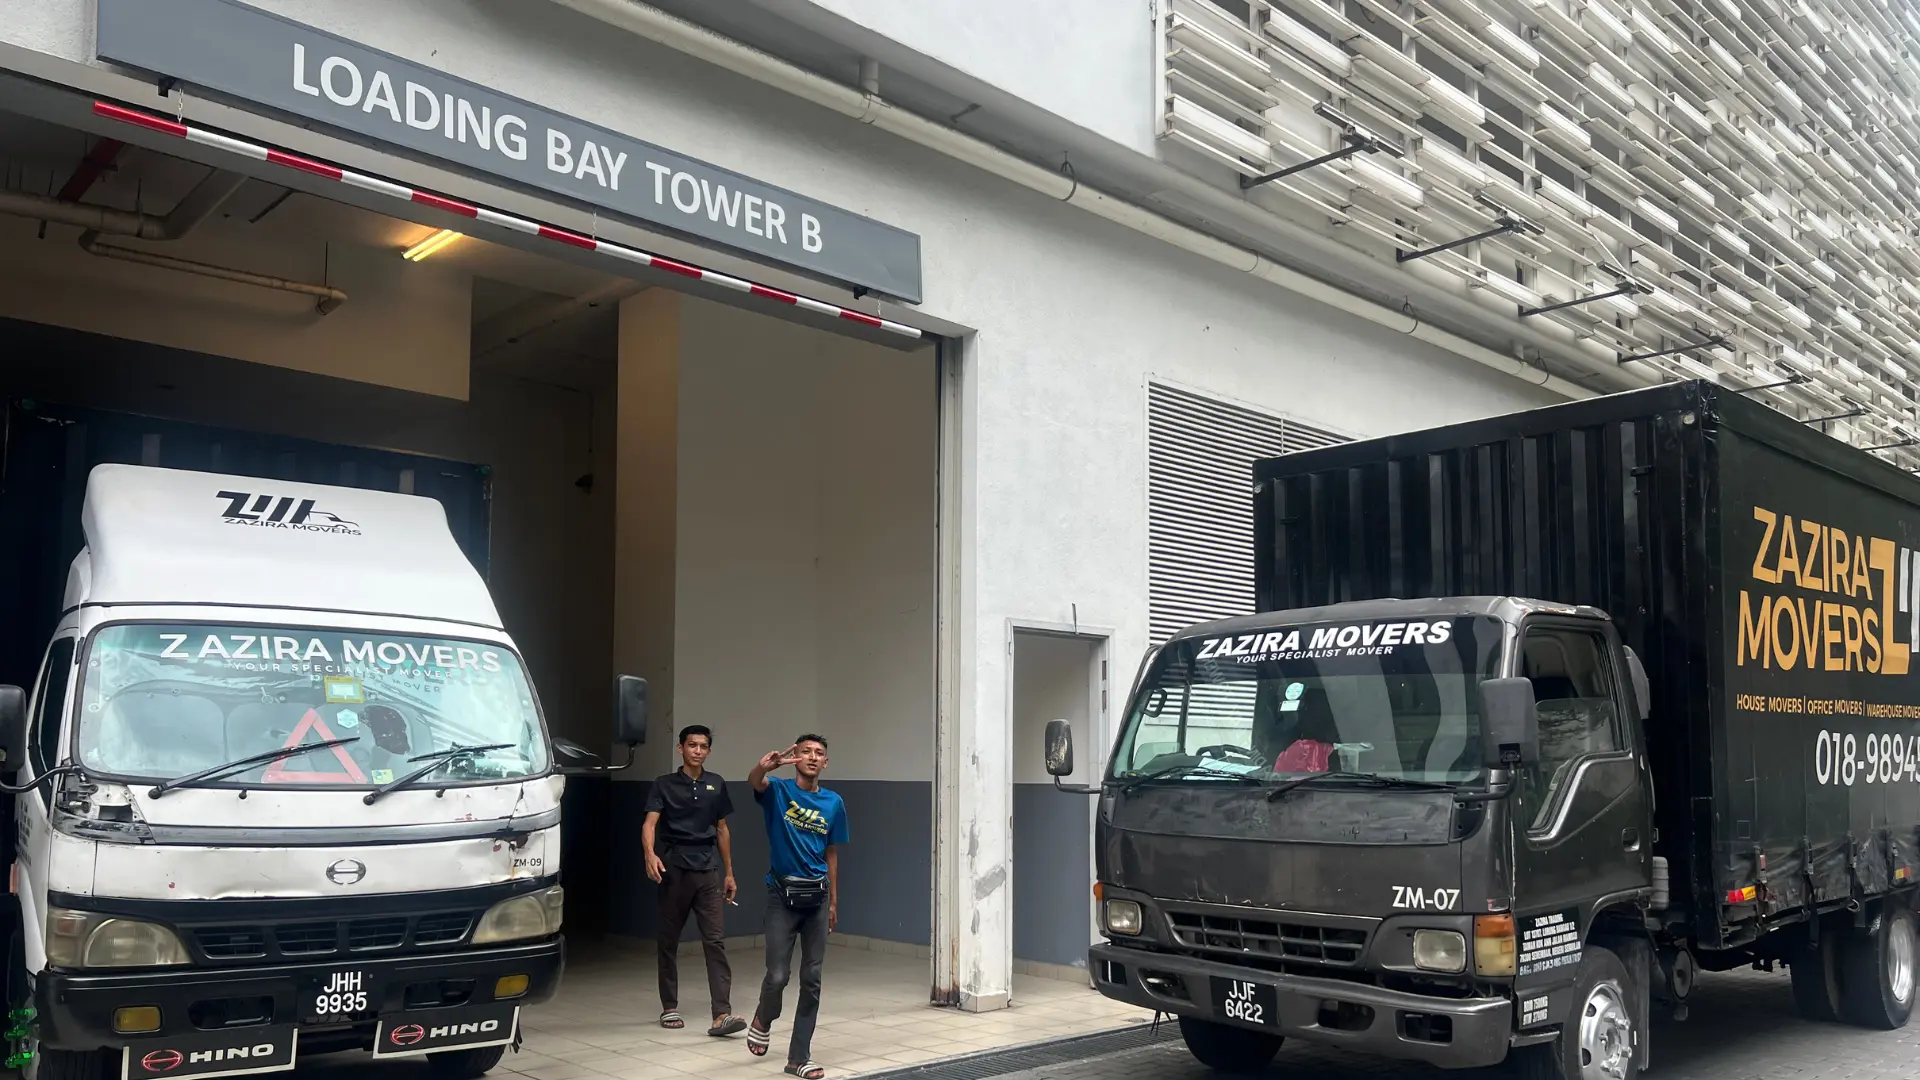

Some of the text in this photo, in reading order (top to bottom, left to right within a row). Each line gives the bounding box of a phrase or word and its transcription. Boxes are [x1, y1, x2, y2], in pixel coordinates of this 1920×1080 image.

[293, 43, 823, 253] LOADING BAY TOWER B
[224, 517, 362, 536] ZAZIRA MOVERS
[1753, 506, 1874, 601] ZAZIRA
[1196, 620, 1451, 660] ZAZIRA MOVERS
[1737, 589, 1882, 674] MOVERS
[342, 639, 502, 673] MOVERS
[1235, 645, 1393, 664] YOUR SPECIALIST MOVER
[234, 662, 453, 679] YOUR SPECIALIST MOVER
[1736, 693, 1765, 712] HOUSE
[1768, 696, 1802, 713] MOVERS
[1807, 699, 1833, 715] OFFICE
[1834, 699, 1863, 716] MOVERS
[1866, 703, 1903, 718] WAREHOUSE
[513, 858, 542, 868] ZM-09
[1391, 886, 1460, 910] ZM-07
[323, 971, 362, 993] JHH
[1228, 980, 1256, 1001] JJF
[316, 992, 367, 1014] 9935
[1225, 999, 1264, 1024] 6422
[430, 1020, 499, 1038] HINO
[190, 1043, 274, 1063] HINO
